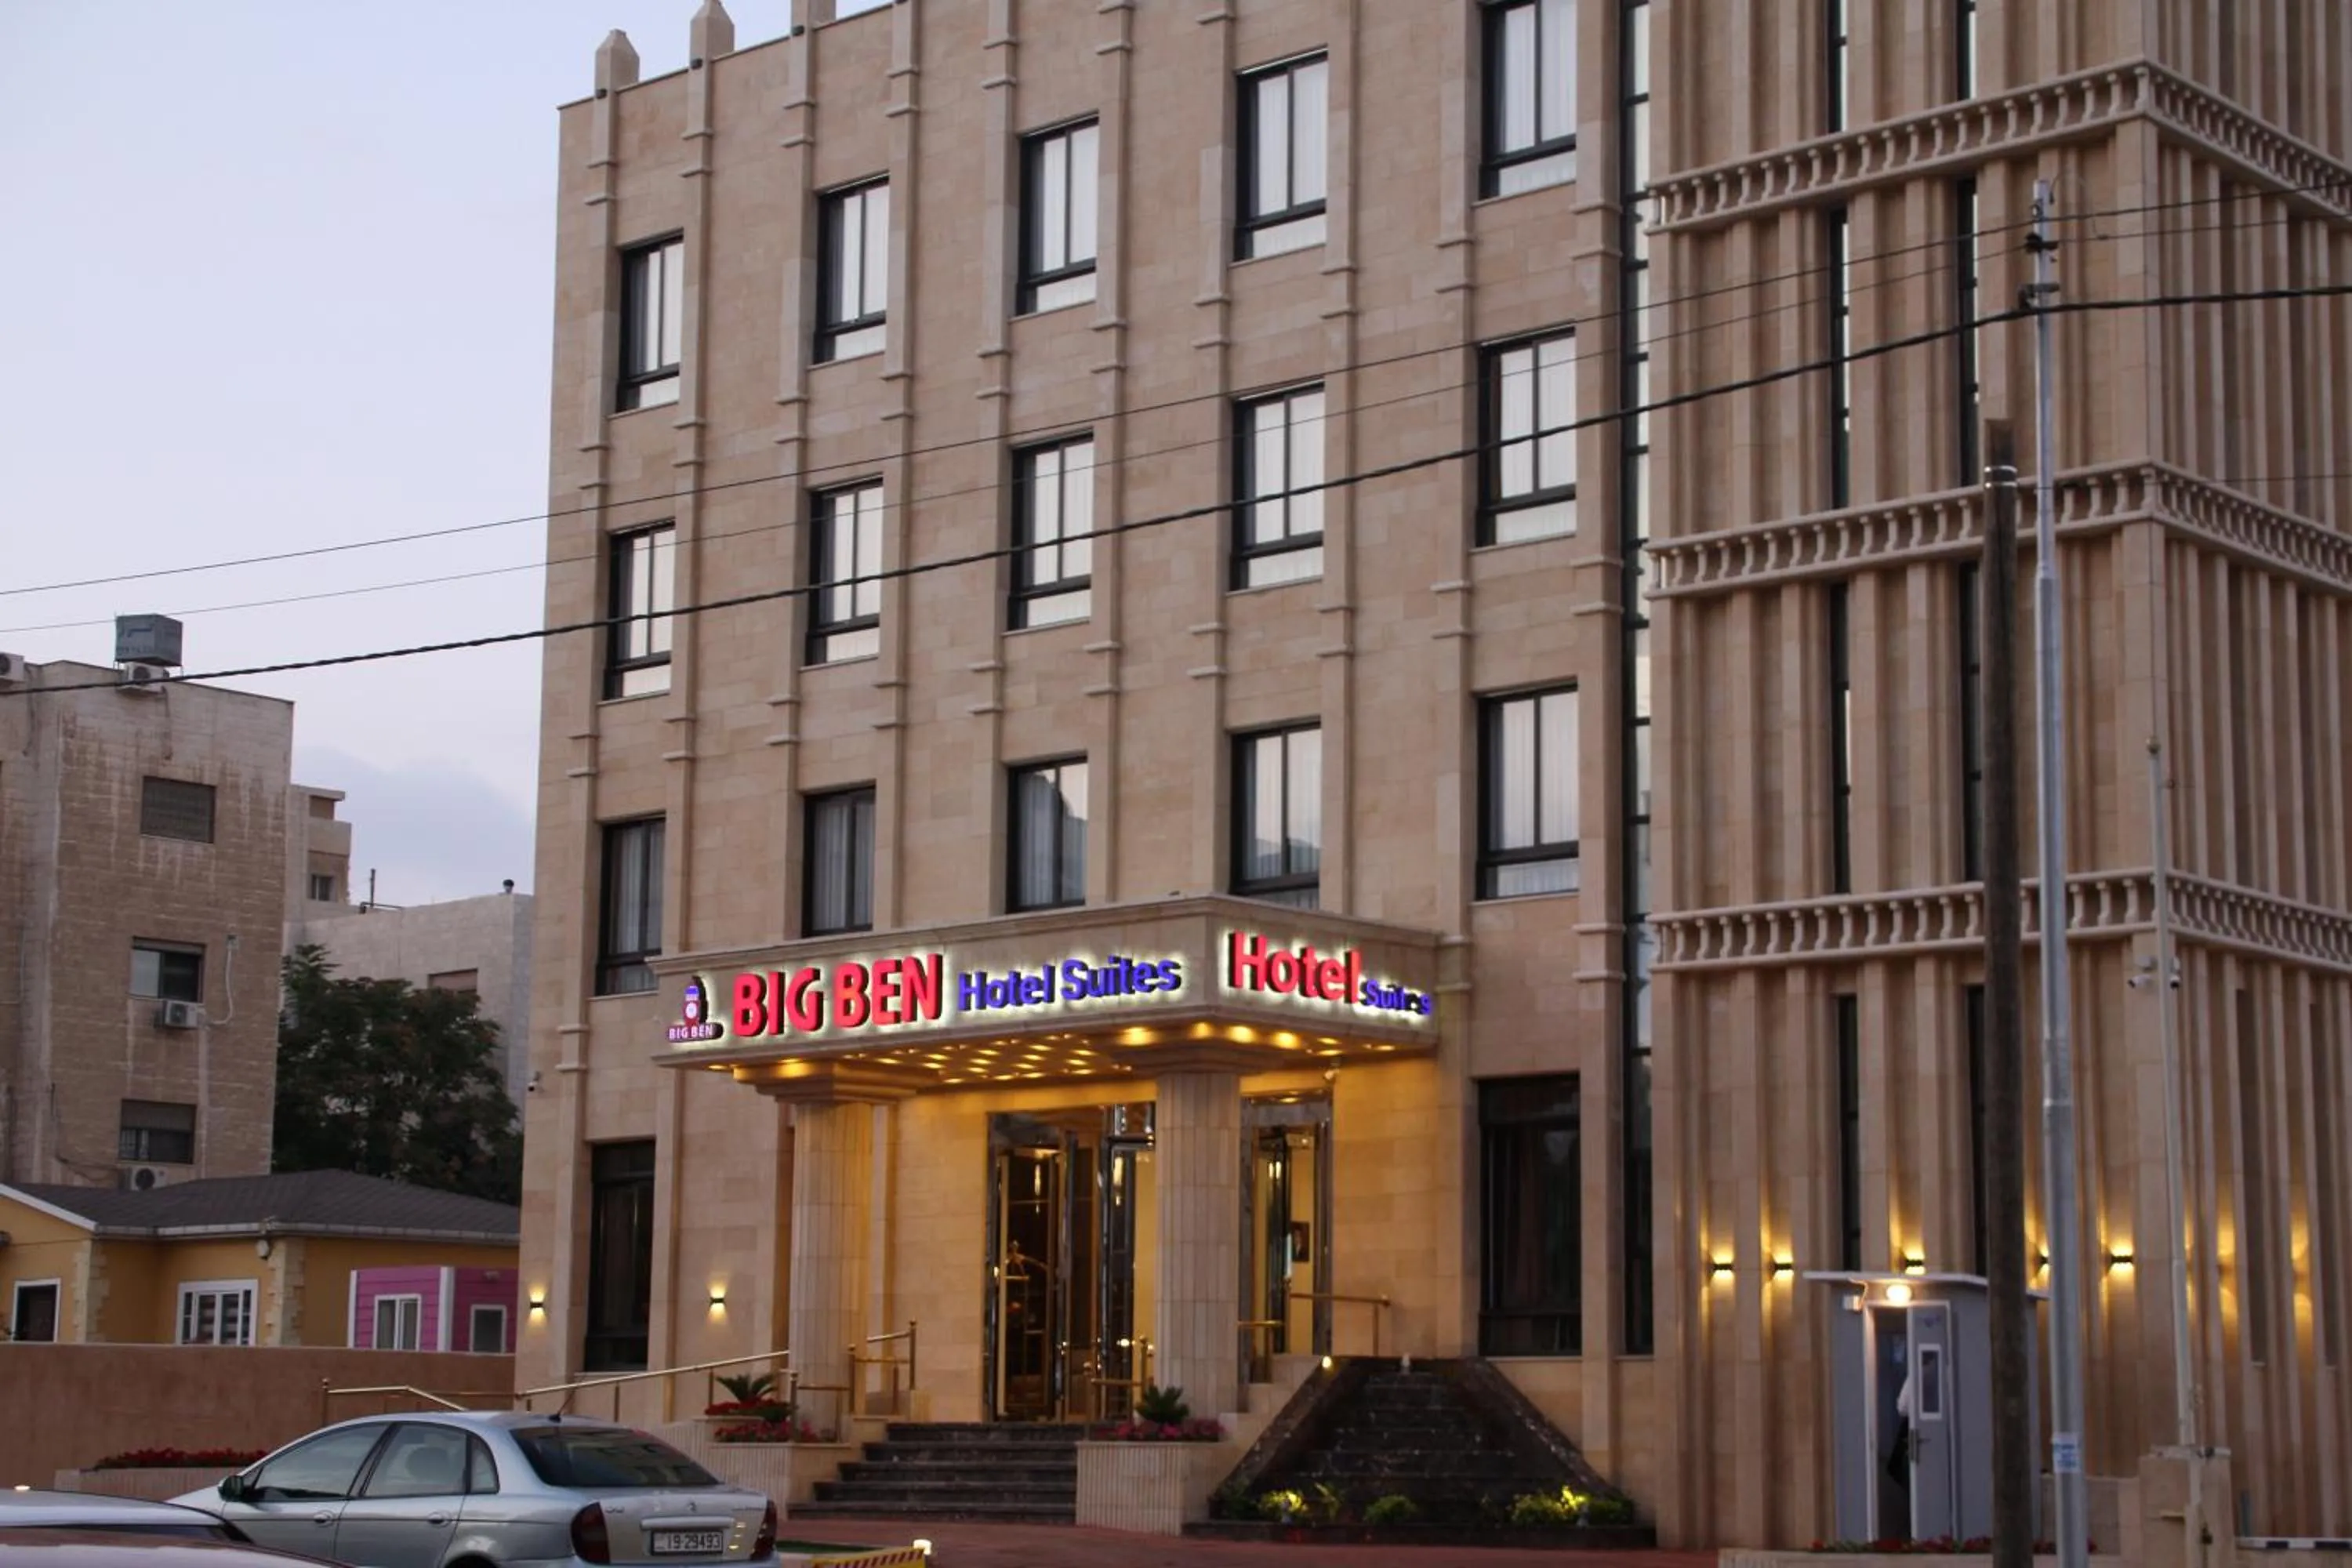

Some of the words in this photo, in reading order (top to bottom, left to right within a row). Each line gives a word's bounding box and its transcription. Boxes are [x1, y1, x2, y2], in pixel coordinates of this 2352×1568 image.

[733, 967, 823, 1036] BIG
[835, 953, 942, 1028] BEN
[958, 965, 1054, 1011] Hotel
[1062, 955, 1180, 1000] Suites
[1229, 930, 1361, 1004] Hotel
[669, 1027, 688, 1040] BIG
[691, 1024, 713, 1038] BEN
